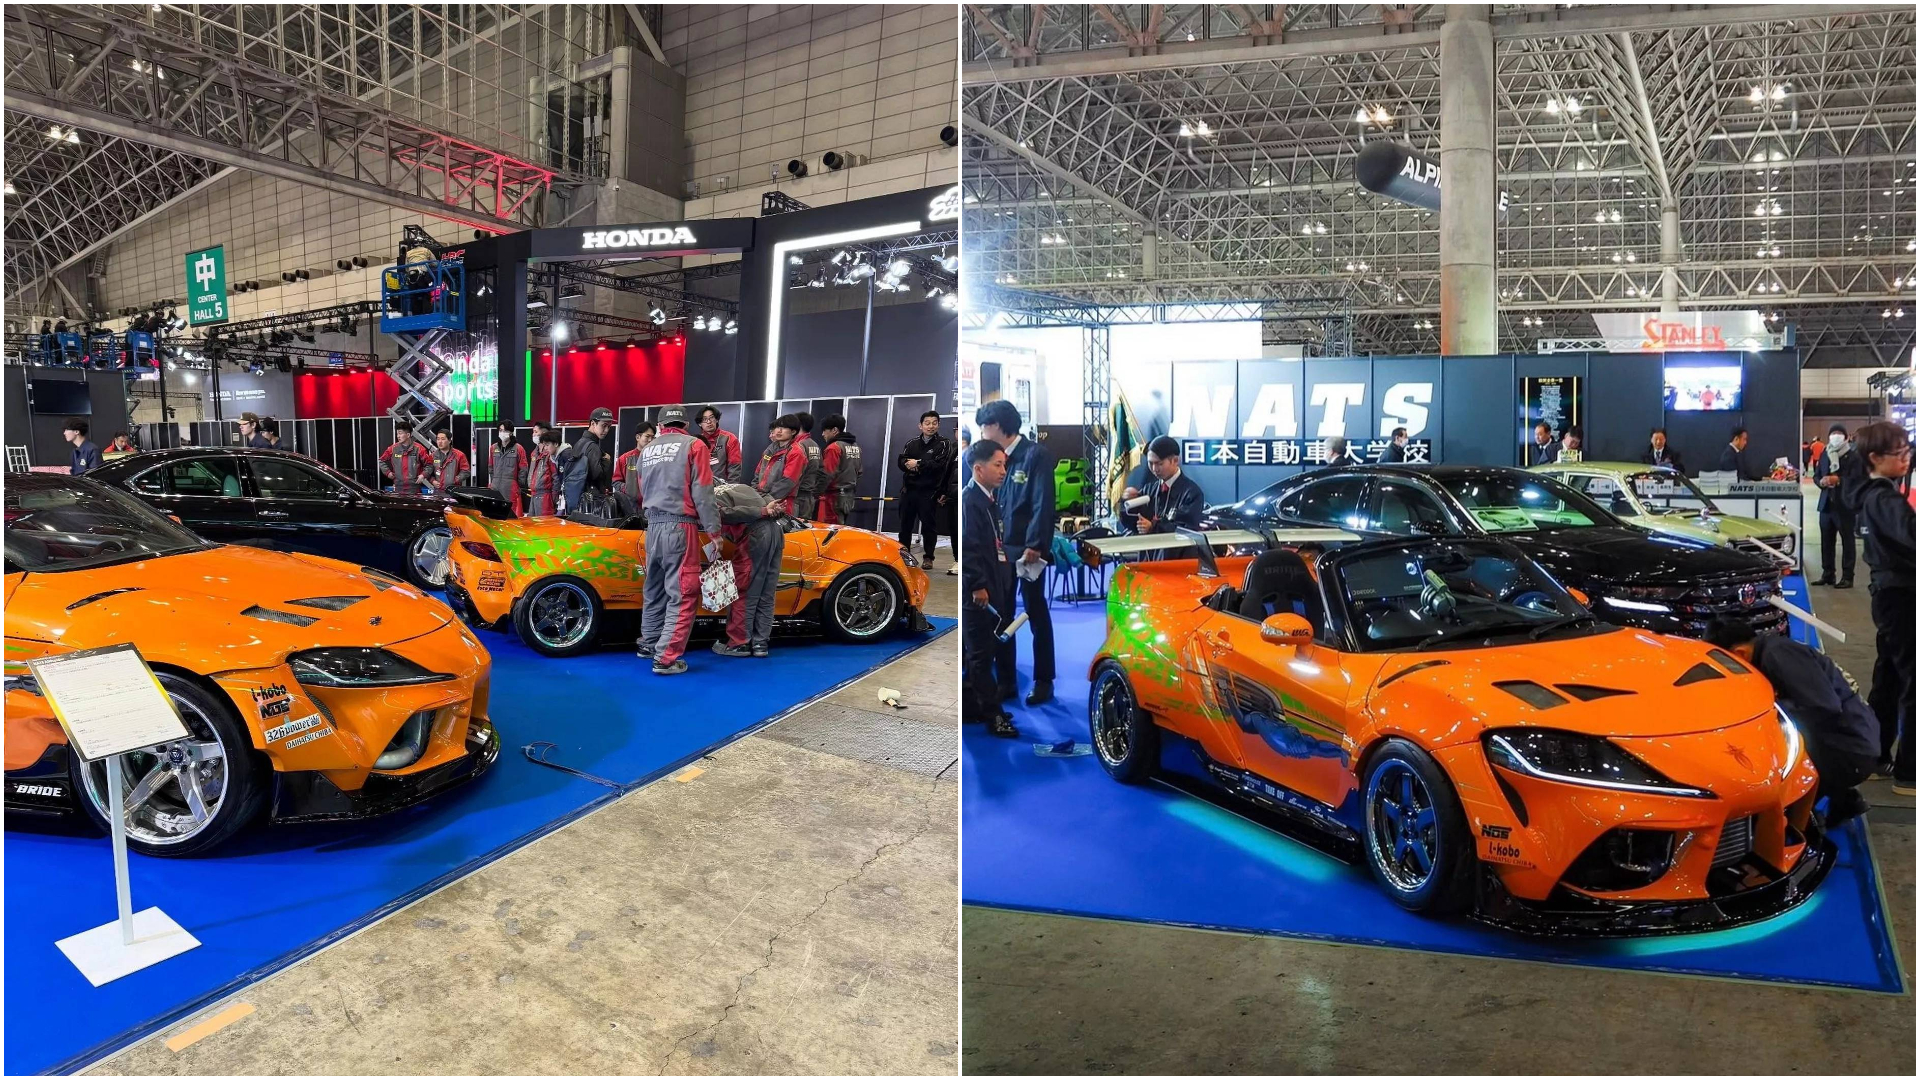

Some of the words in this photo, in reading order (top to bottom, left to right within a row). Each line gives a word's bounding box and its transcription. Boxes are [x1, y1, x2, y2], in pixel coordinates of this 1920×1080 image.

[1399, 155, 1509, 212] ALPIE
[582, 226, 697, 249] HONDA
[195, 253, 216, 292] 中
[197, 293, 217, 304] CENTER
[194, 308, 214, 321] HALL
[214, 301, 223, 318] 5
[1168, 382, 1434, 438] NATS
[642, 442, 682, 459] NATS
[286, 732, 315, 749] DAIHATSU
[16, 784, 63, 797] BRIDE
